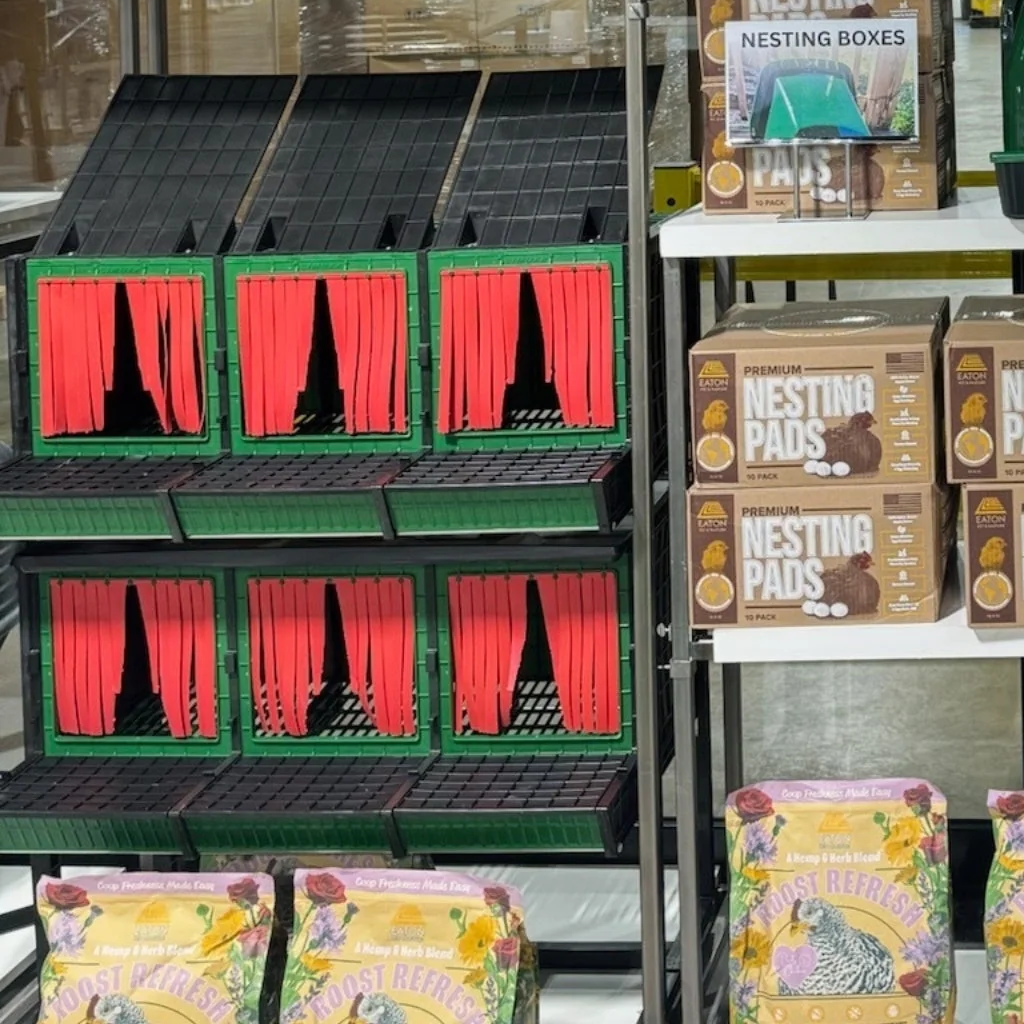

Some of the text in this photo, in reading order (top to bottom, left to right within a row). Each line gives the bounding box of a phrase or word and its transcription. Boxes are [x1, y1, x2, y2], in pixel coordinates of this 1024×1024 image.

[741, 30, 905, 48] NESTING BOXES
[753, 147, 832, 188] PADS
[764, 199, 786, 207] PACK
[744, 365, 802, 376] PREMIUM
[957, 372, 987, 381] EATON
[699, 378, 728, 387] EATON
[743, 373, 875, 419] NESTING
[744, 418, 827, 462] PADS
[742, 506, 800, 517] PREMIUM
[698, 518, 727, 527] EATON
[976, 515, 1006, 524] EATON
[742, 514, 873, 559] NESTING
[743, 557, 825, 601] PADS
[781, 789, 802, 799] Coop
[845, 787, 870, 797] Made
[793, 853, 820, 865] Hemp
[829, 852, 850, 863] Herb
[850, 851, 881, 862] Blend
[97, 880, 120, 891] Coop
[166, 880, 192, 890] Made
[422, 880, 448, 891] Made
[755, 868, 924, 928] ROOST REFRESH
[130, 962, 233, 1023] REFRESH
[309, 963, 386, 1021] ROOST
